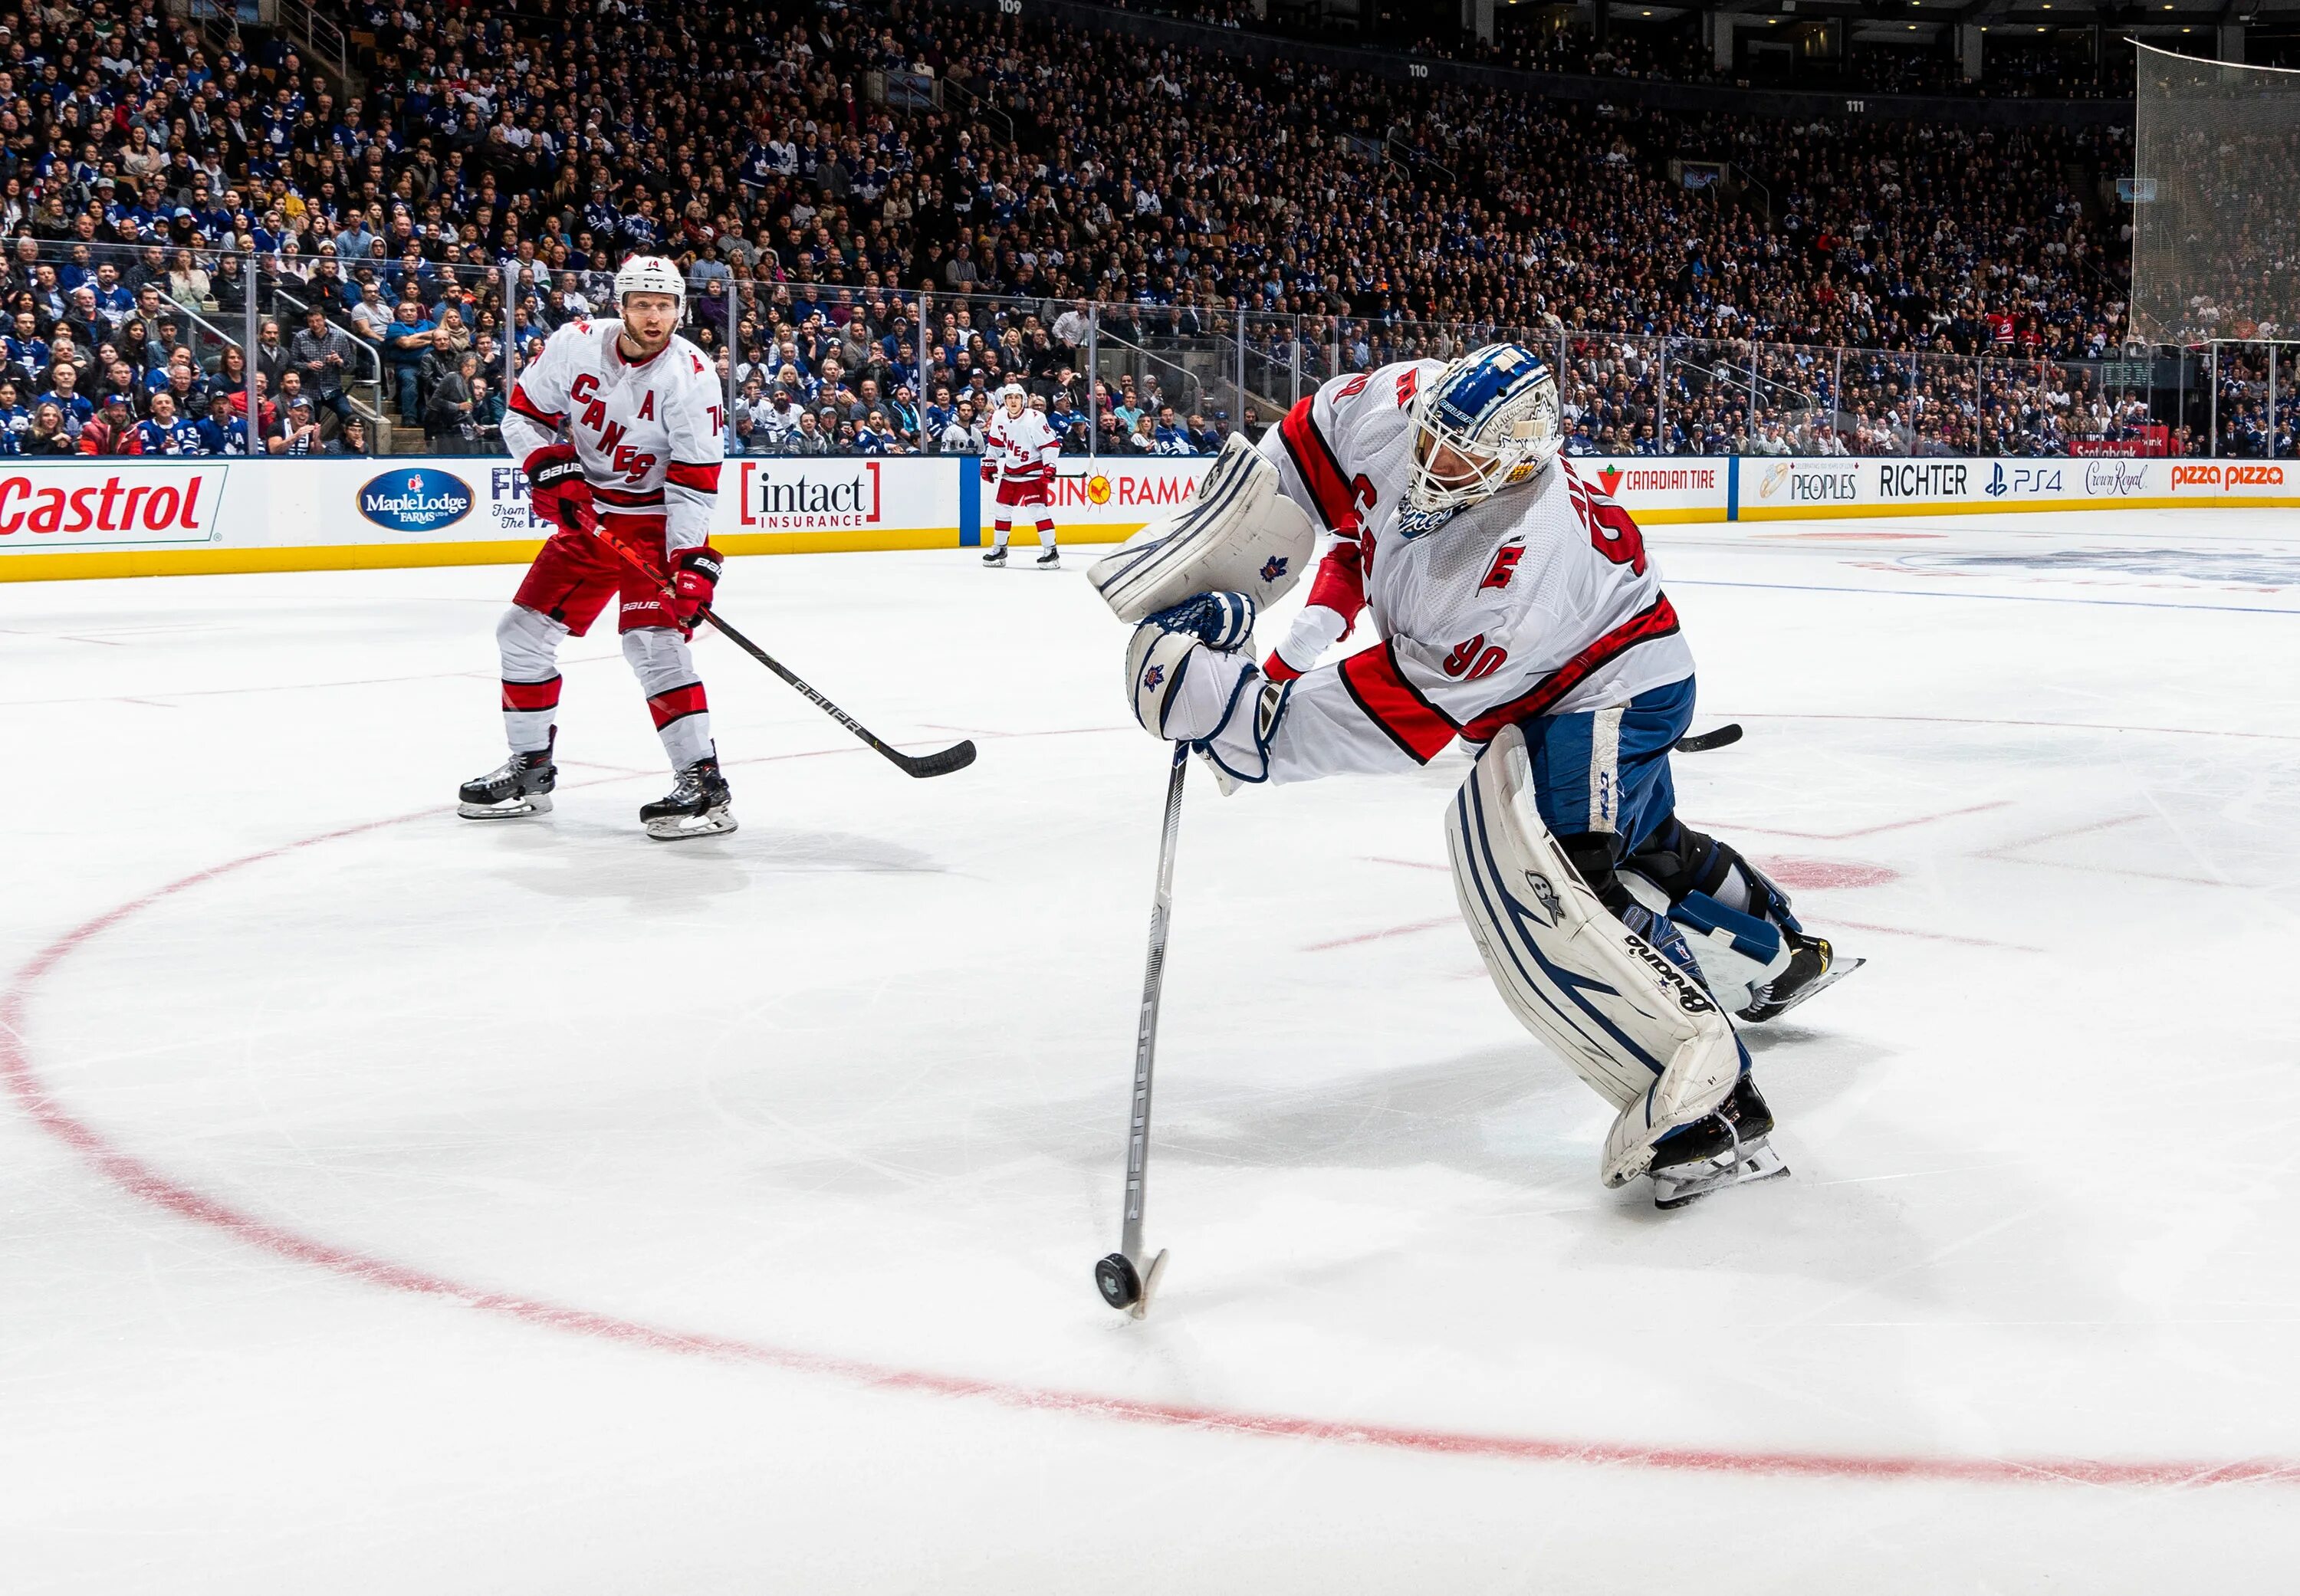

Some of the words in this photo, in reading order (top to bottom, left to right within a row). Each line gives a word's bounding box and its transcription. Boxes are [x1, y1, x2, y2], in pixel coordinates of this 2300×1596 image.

[998, 0, 1022, 15] 109
[1409, 64, 1428, 77] 110
[1846, 100, 1864, 112] 111
[2103, 363, 2155, 386] IBM
[637, 389, 654, 422] A
[570, 373, 657, 484] CANES
[997, 425, 1030, 462] CANES
[2077, 445, 2137, 457] Scotabank
[1627, 471, 1687, 491] CANADIAN
[1691, 470, 1714, 489] TIRE
[1791, 475, 1856, 500] PEOPLES
[1881, 465, 1967, 497] RICHTER
[2015, 469, 2062, 492] PS4
[2085, 461, 2113, 495] Crown
[2107, 461, 2148, 495] Royal
[2171, 466, 2220, 491] pizza
[2225, 466, 2284, 491] pizza
[759, 472, 866, 513] intact
[0, 476, 202, 535] Castrol
[492, 504, 526, 517] From
[399, 512, 435, 524] FARMS
[501, 517, 525, 529] The
[761, 515, 863, 528] INSURANCE
[622, 601, 664, 612] BAUE
[1443, 633, 1508, 681] 90
[793, 681, 861, 734] BAUER
[1127, 1001, 1153, 1220] BAUER
